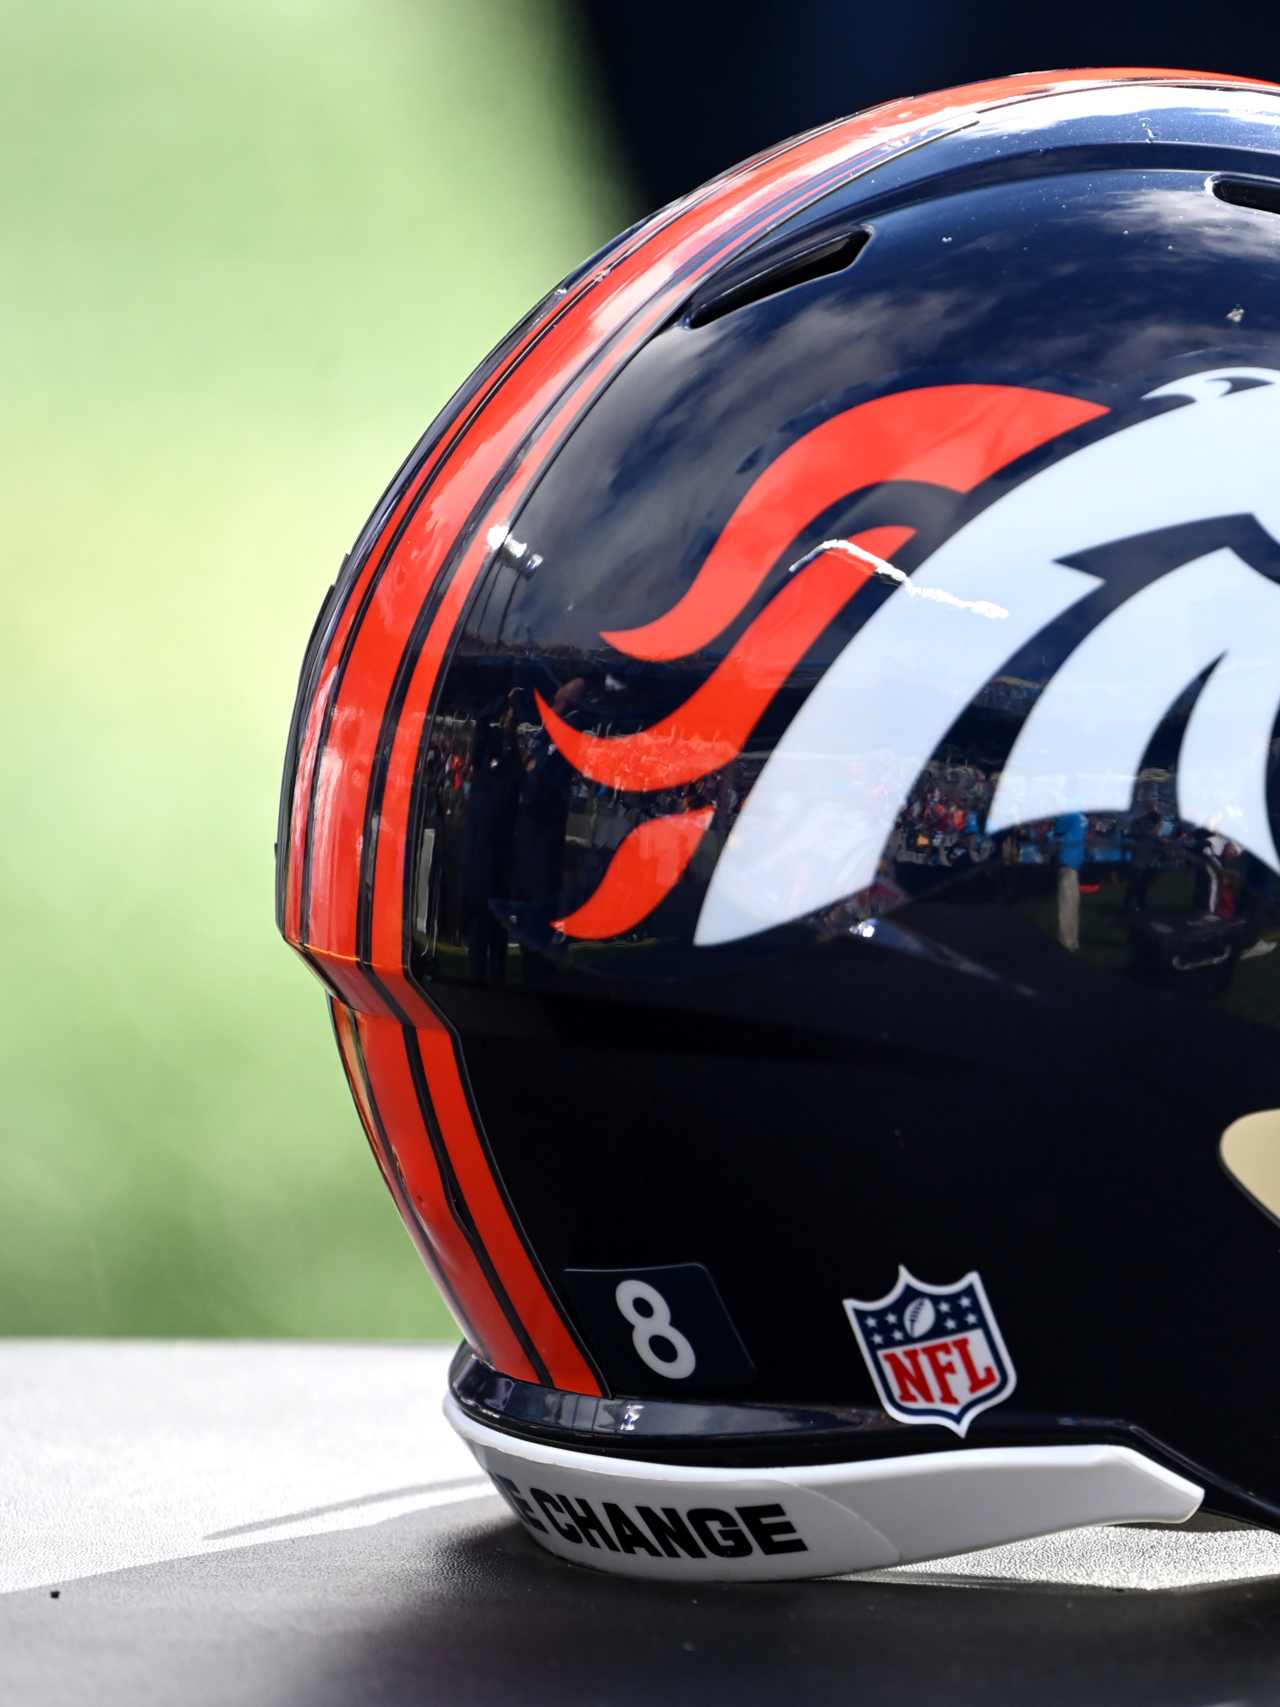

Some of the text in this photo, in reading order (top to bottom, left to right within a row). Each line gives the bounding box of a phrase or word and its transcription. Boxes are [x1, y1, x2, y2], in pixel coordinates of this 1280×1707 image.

[615, 1279, 696, 1379] 8
[883, 1337, 997, 1405] NFL
[490, 1471, 809, 1559] E CHANGE
